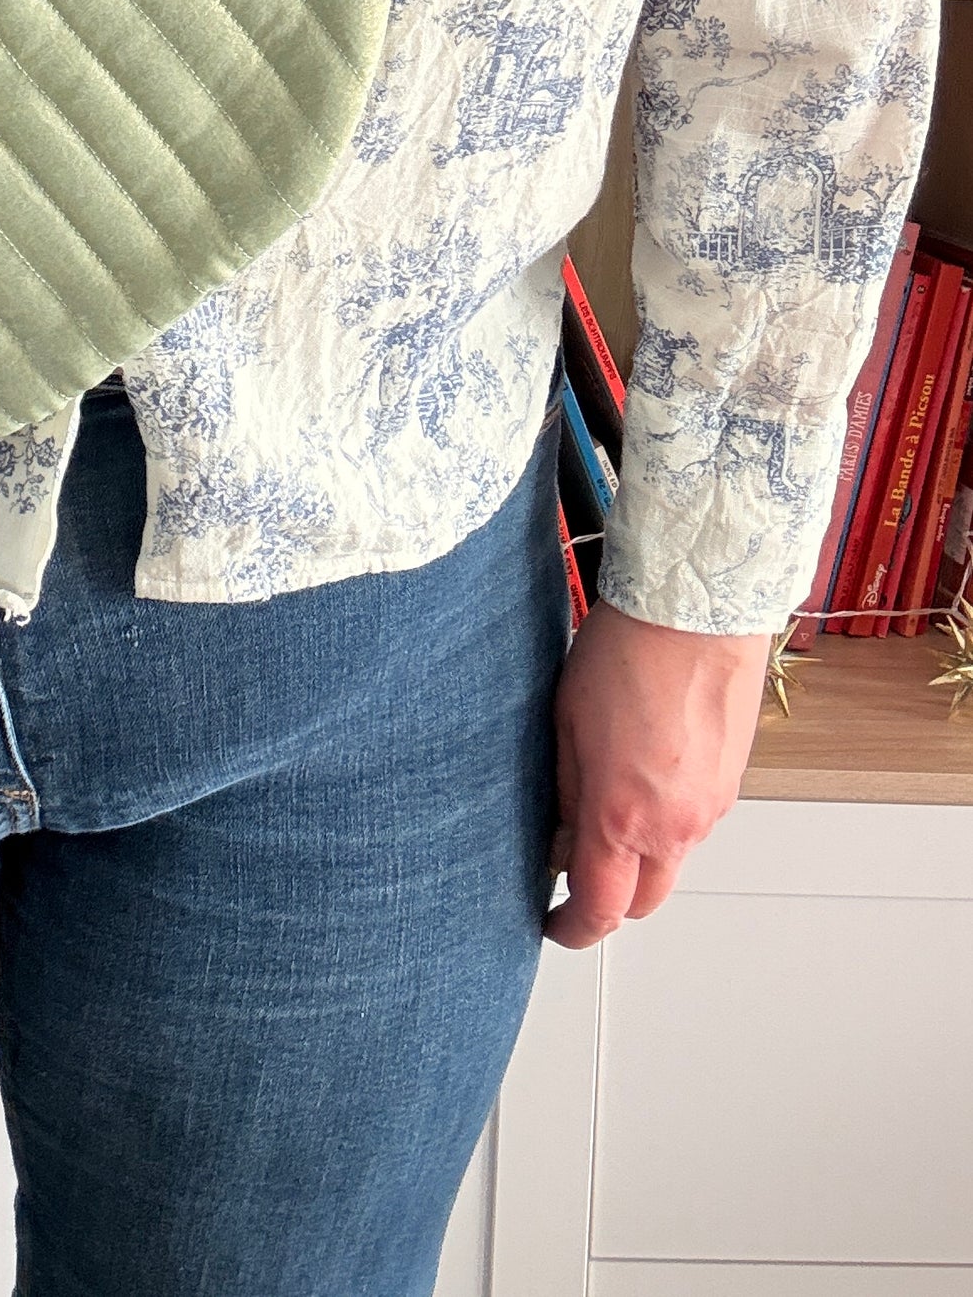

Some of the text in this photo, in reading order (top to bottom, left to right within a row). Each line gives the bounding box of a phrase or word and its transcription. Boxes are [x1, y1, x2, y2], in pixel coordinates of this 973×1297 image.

[883, 373, 936, 529] La Bande à Picsou
